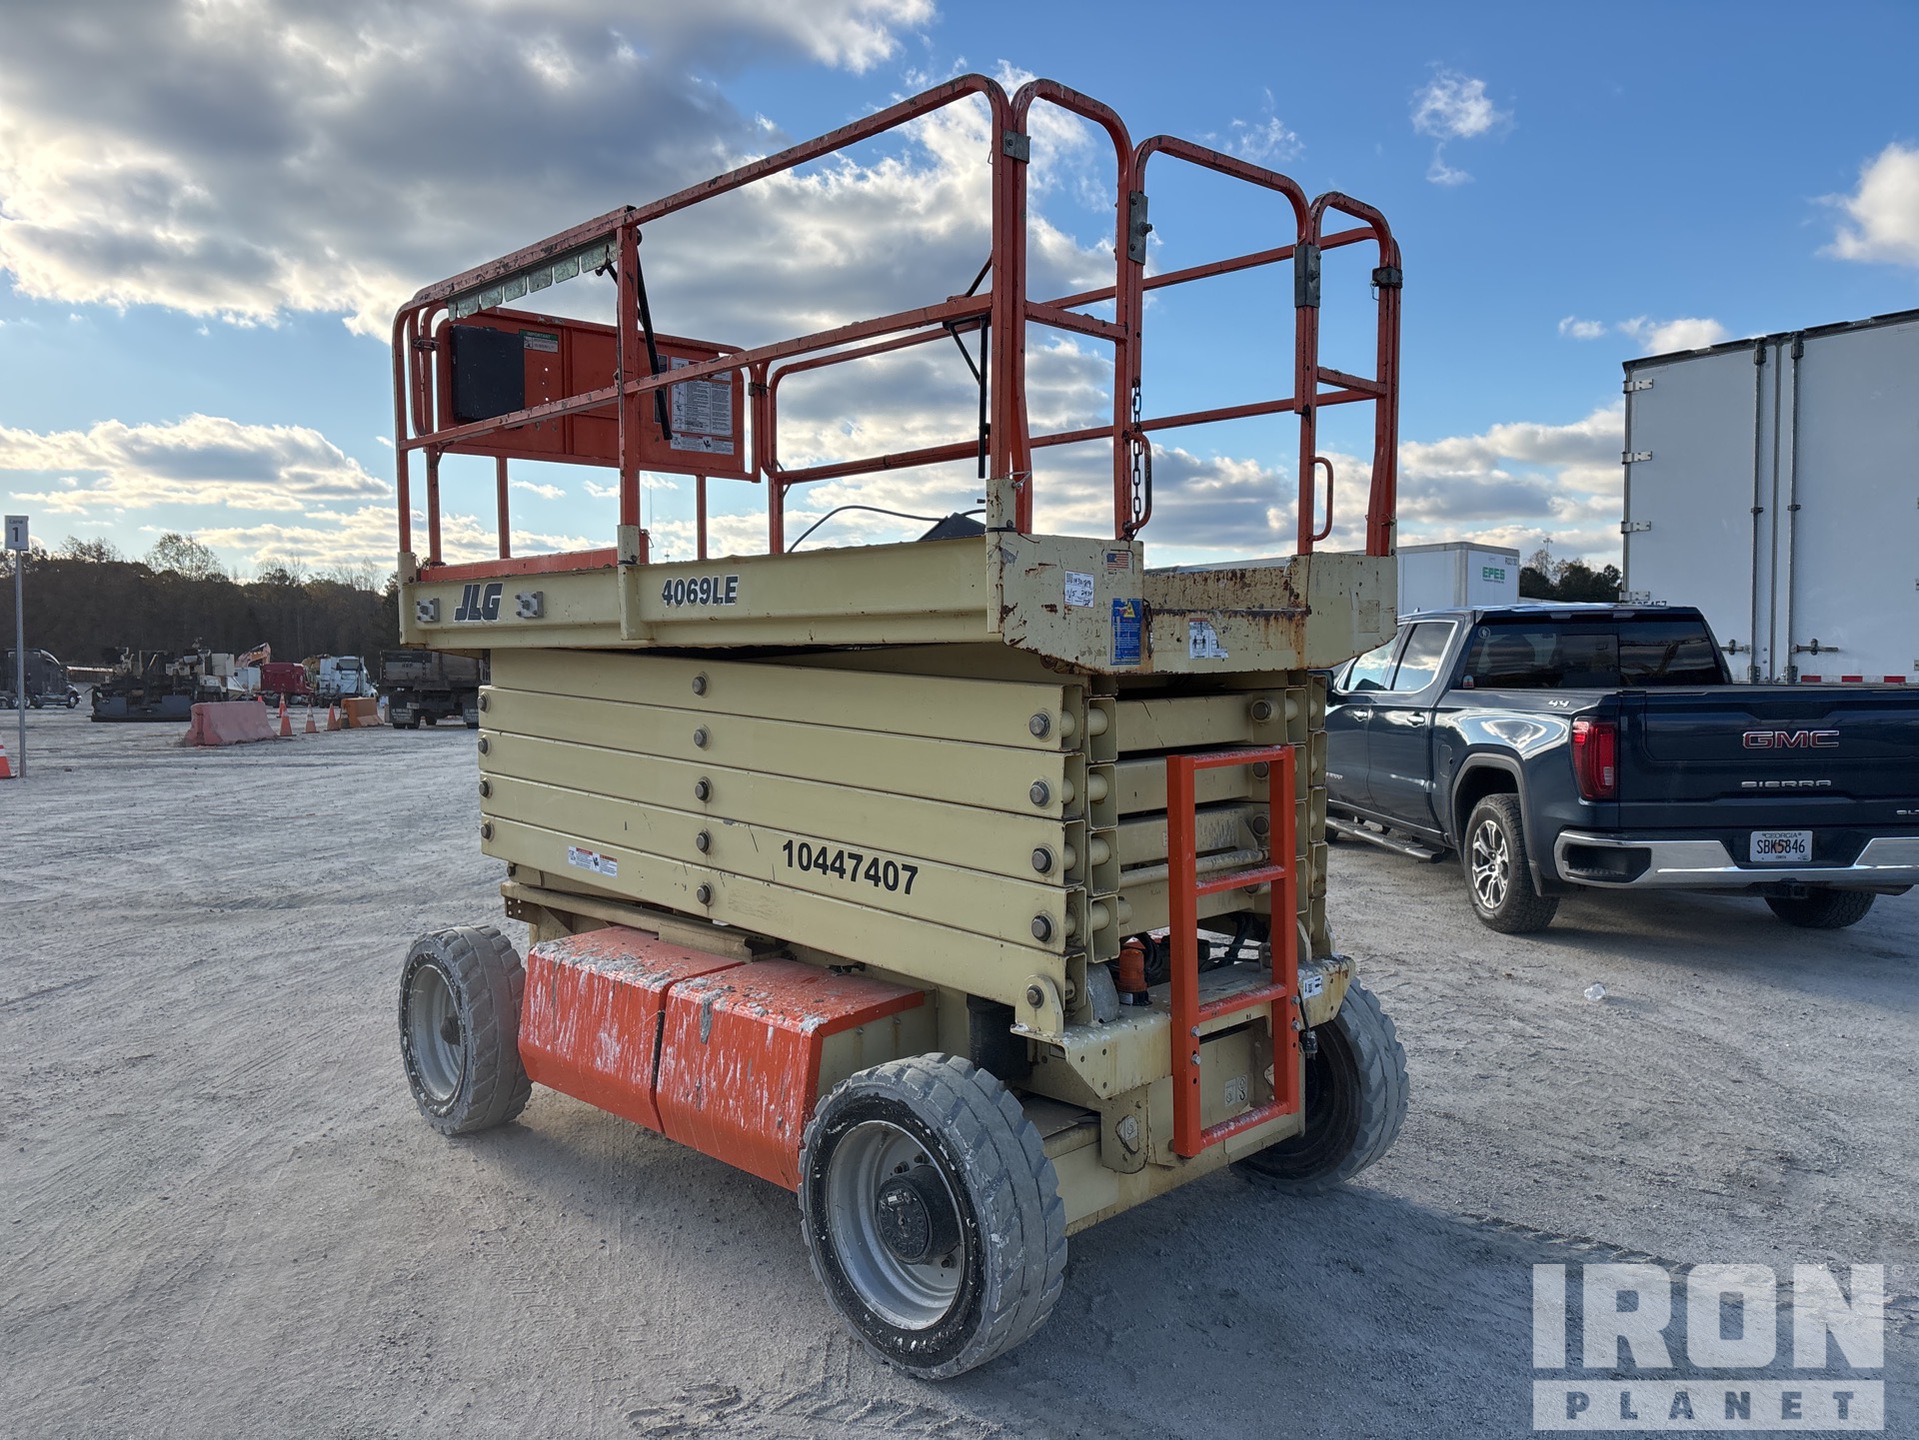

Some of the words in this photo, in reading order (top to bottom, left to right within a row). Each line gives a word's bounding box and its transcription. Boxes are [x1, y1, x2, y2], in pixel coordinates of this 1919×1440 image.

[12, 527, 19, 542] 1
[1482, 566, 1505, 581] EPES
[661, 575, 739, 607] 4069LE
[454, 582, 503, 621] JLG
[1742, 730, 1840, 749] GMC
[1741, 779, 1832, 789] SIERRA
[1756, 838, 1806, 855] SBK5846
[782, 838, 919, 896] 10447407
